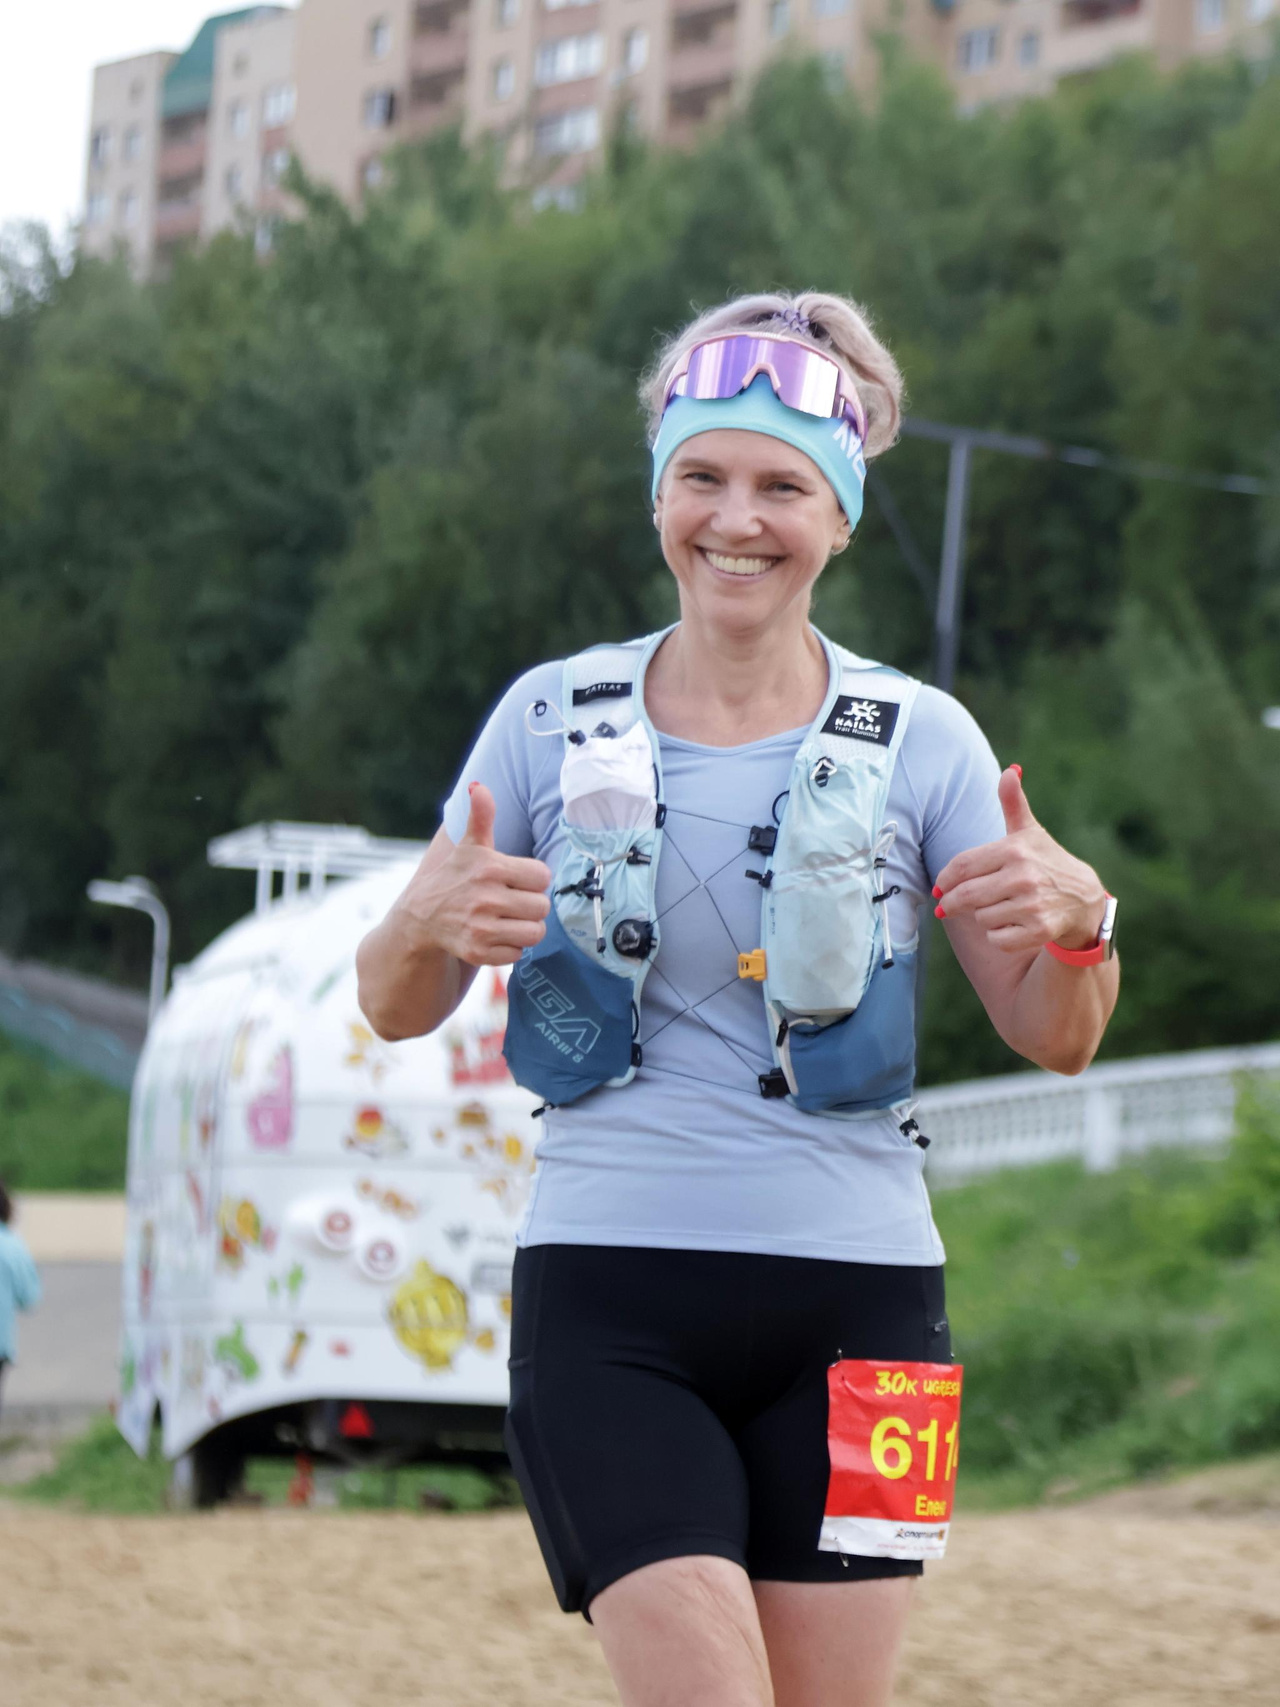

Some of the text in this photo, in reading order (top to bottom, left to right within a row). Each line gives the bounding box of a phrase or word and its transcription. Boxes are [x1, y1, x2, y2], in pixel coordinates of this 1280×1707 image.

[835, 717, 882, 733] KAILAS
[514, 946, 602, 1054] UGA
[870, 1416, 958, 1481] 611
